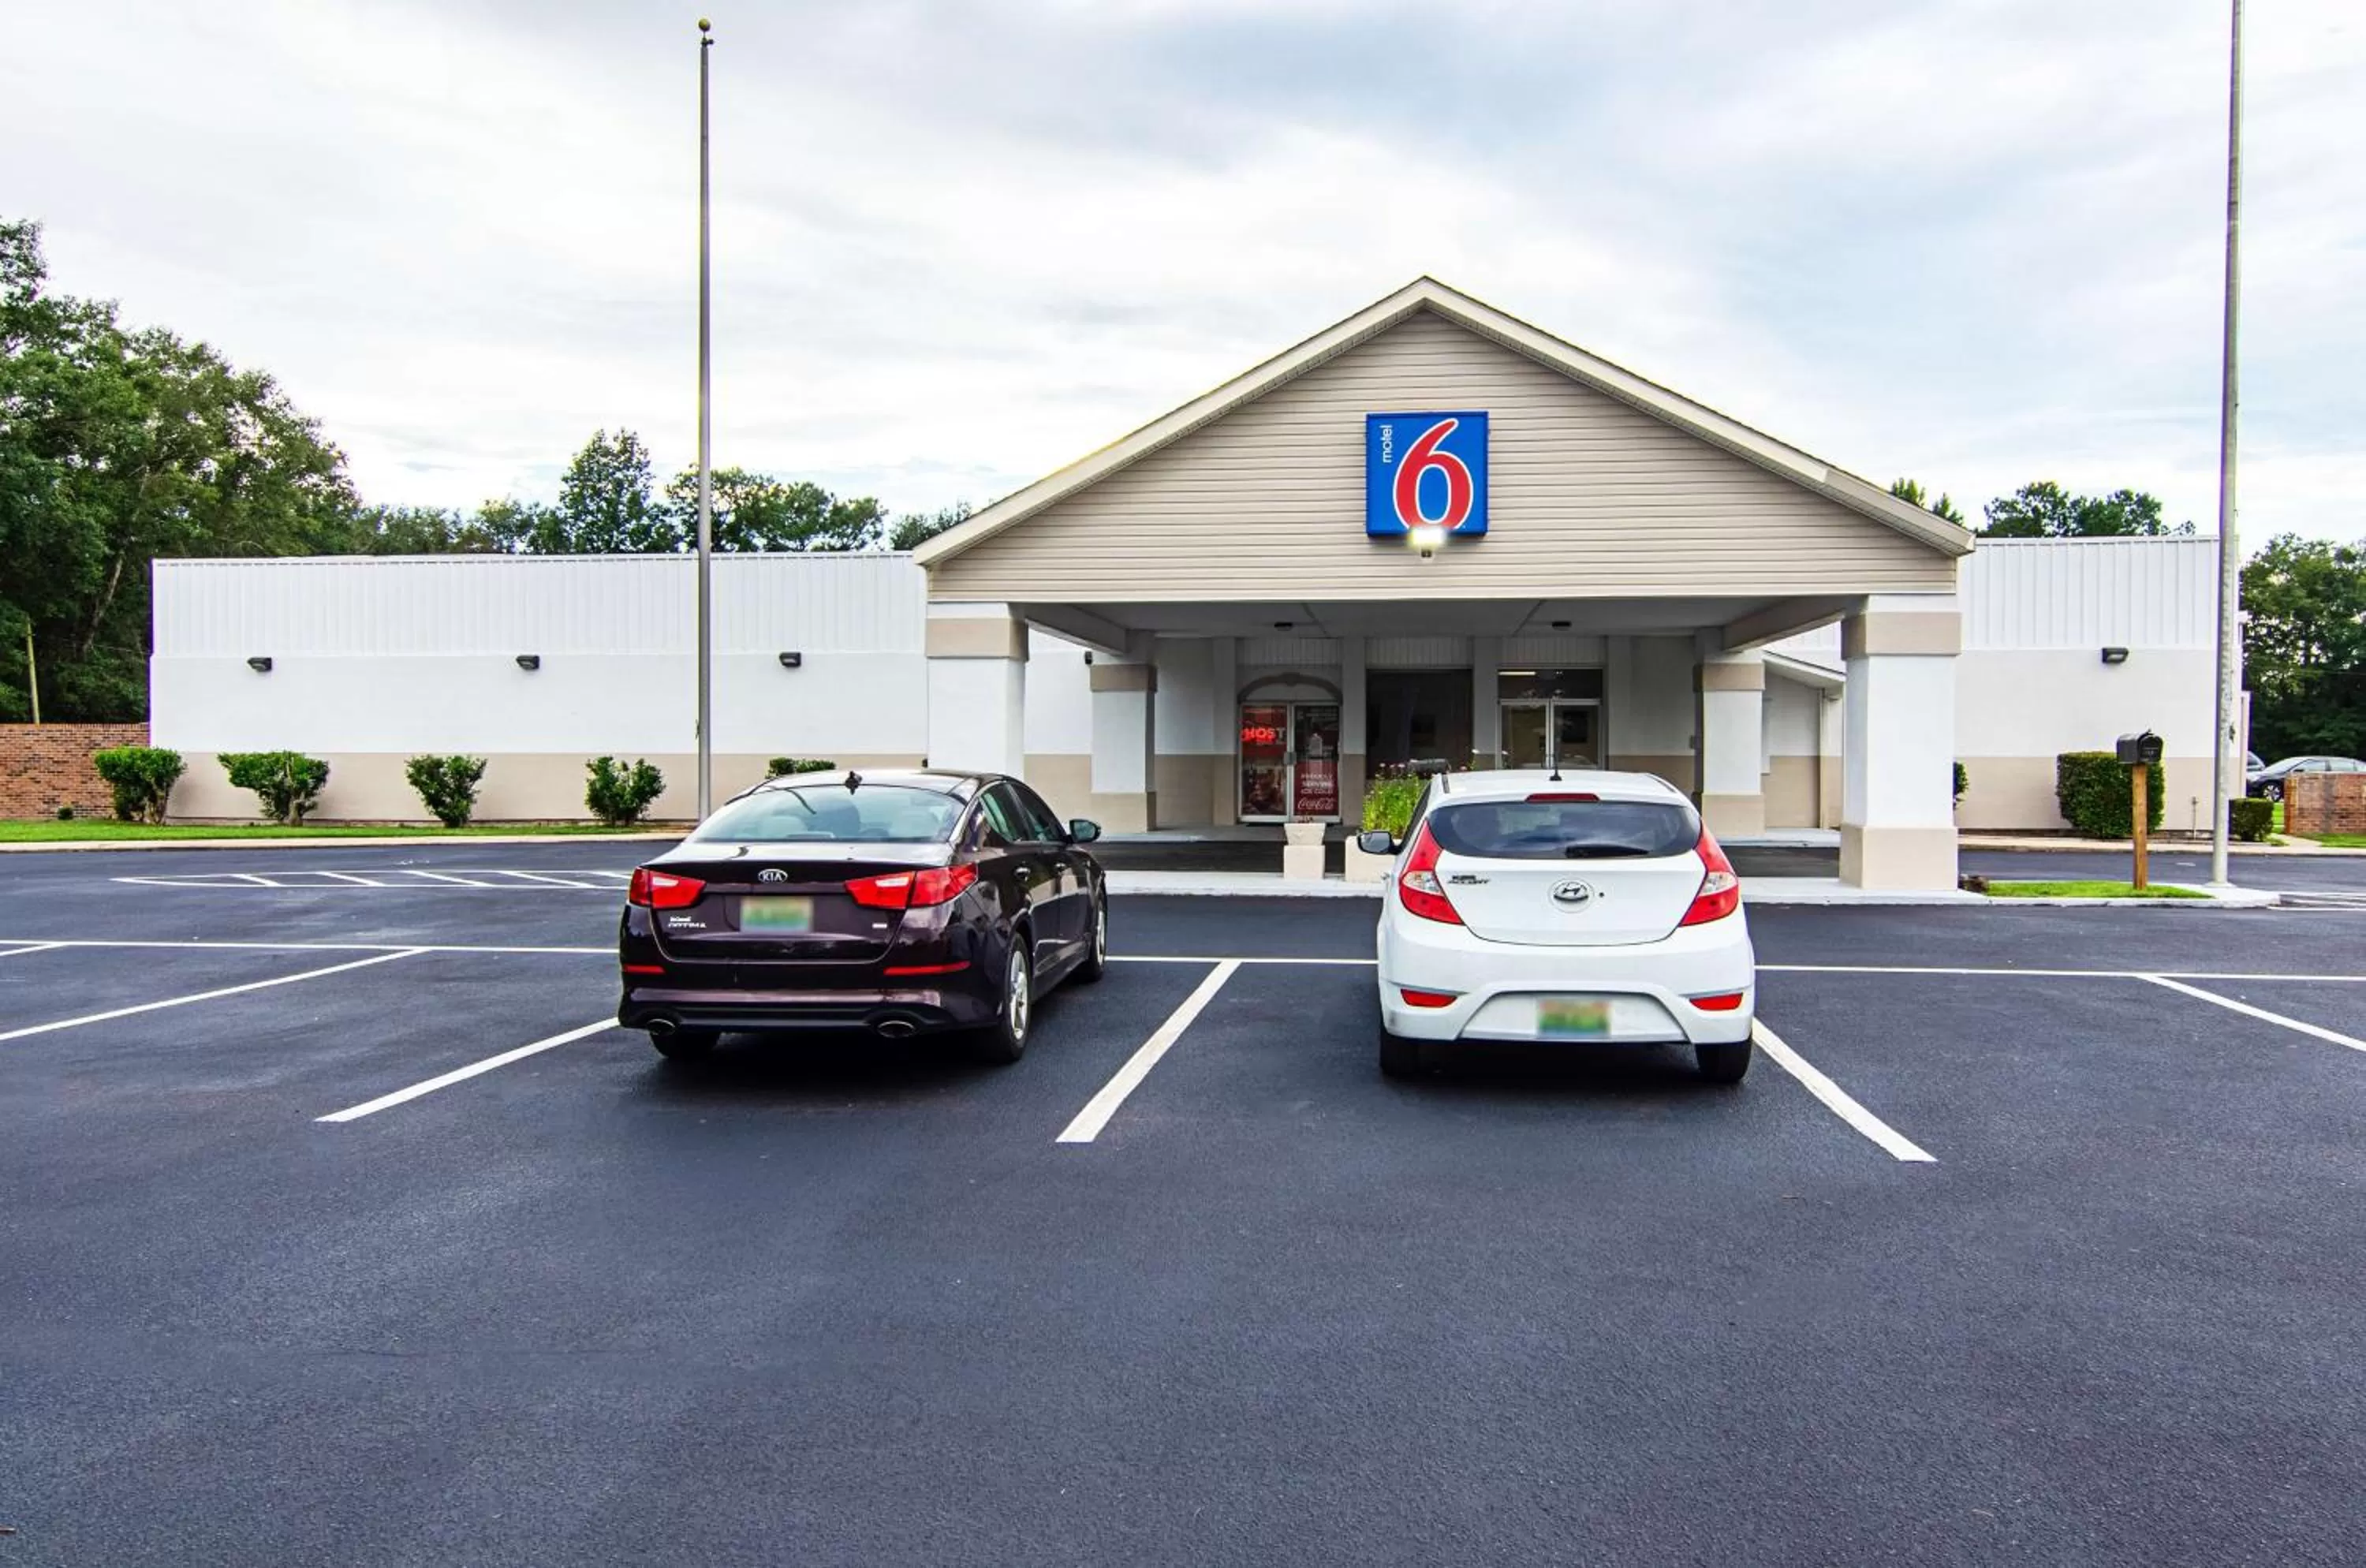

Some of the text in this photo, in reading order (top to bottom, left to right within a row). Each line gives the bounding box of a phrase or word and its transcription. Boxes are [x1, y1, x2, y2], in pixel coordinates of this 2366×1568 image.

[1379, 418, 1474, 529] motel 6
[762, 871, 783, 882] KIA
